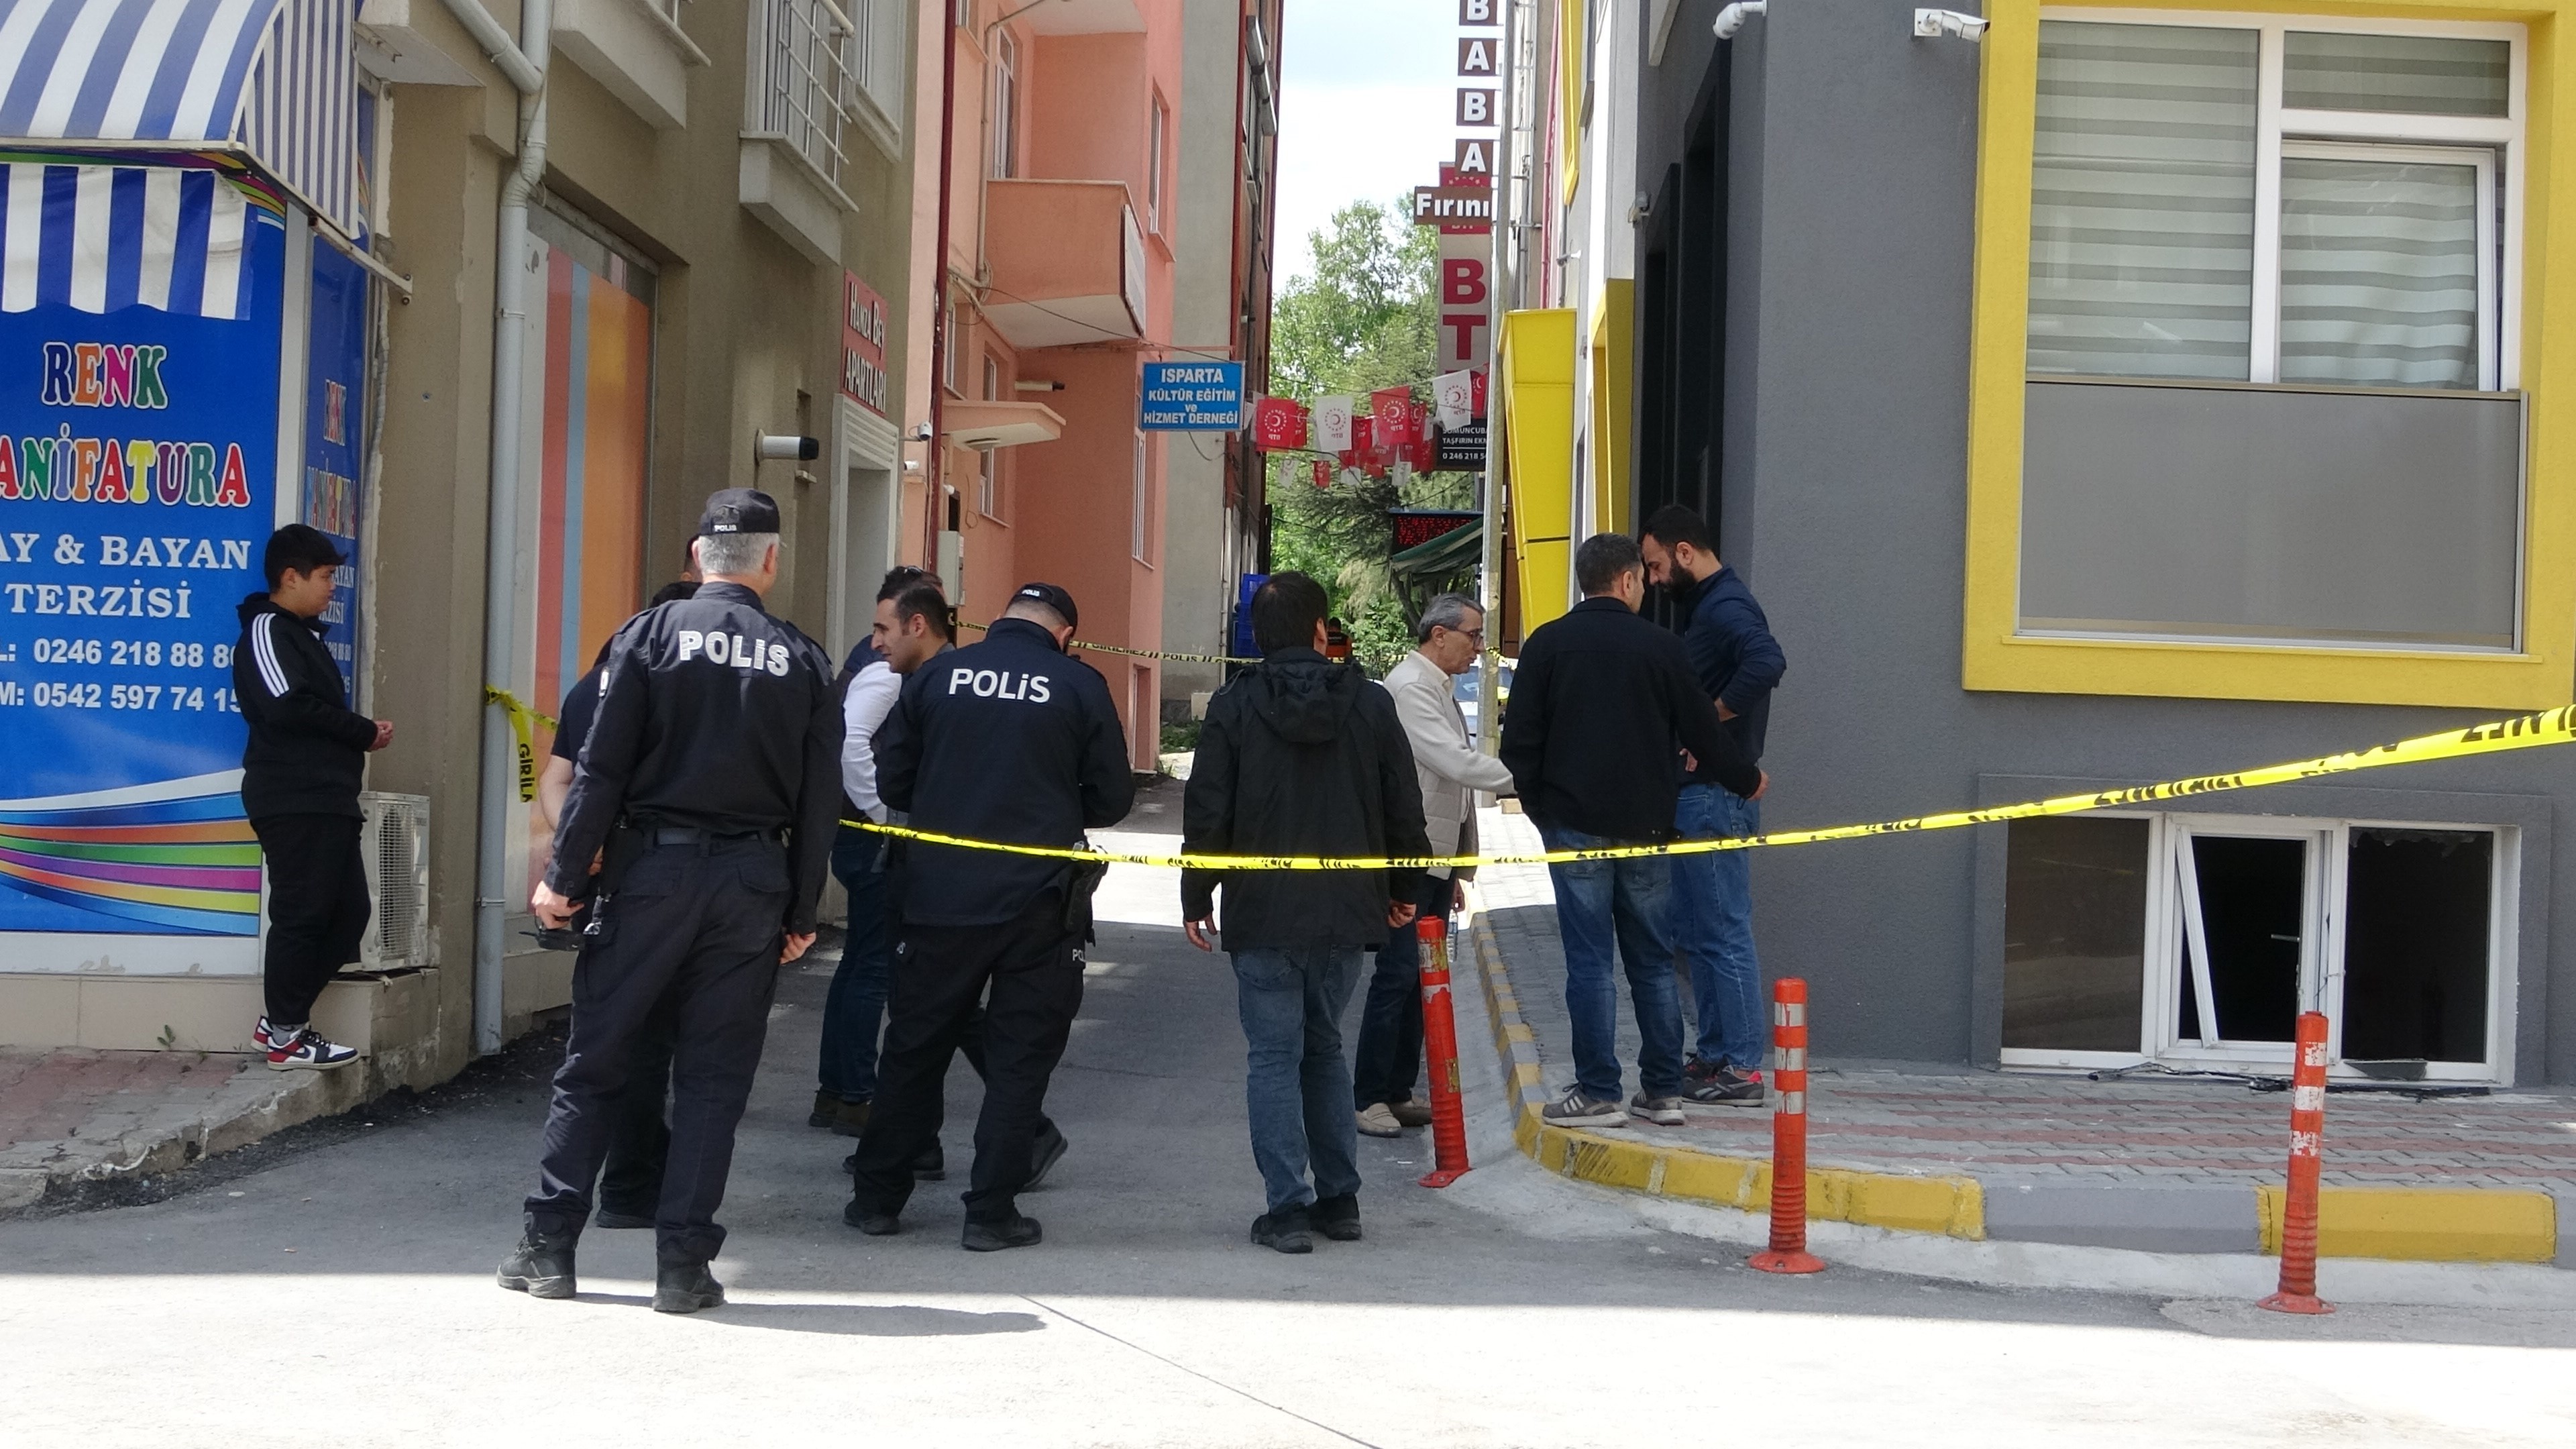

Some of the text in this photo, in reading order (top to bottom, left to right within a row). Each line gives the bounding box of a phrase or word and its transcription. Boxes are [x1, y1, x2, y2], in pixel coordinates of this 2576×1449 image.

[42, 341, 168, 409] RENK
[1161, 368, 1224, 383] ISPARTA
[1148, 388, 1236, 401] KÜLTÜR EĞİTİM
[1185, 404, 1197, 413] ve
[1144, 411, 1238, 424] HİZMET DERNEĞİ
[54, 534, 85, 565] &
[100, 535, 251, 570] BAYAN
[4, 578, 192, 619] TERZİSİ
[34, 639, 101, 664] 0246
[110, 641, 162, 666] 218
[170, 643, 204, 667] 88
[34, 682, 101, 708] 0542
[110, 684, 162, 710] 597
[170, 686, 204, 712] 74
